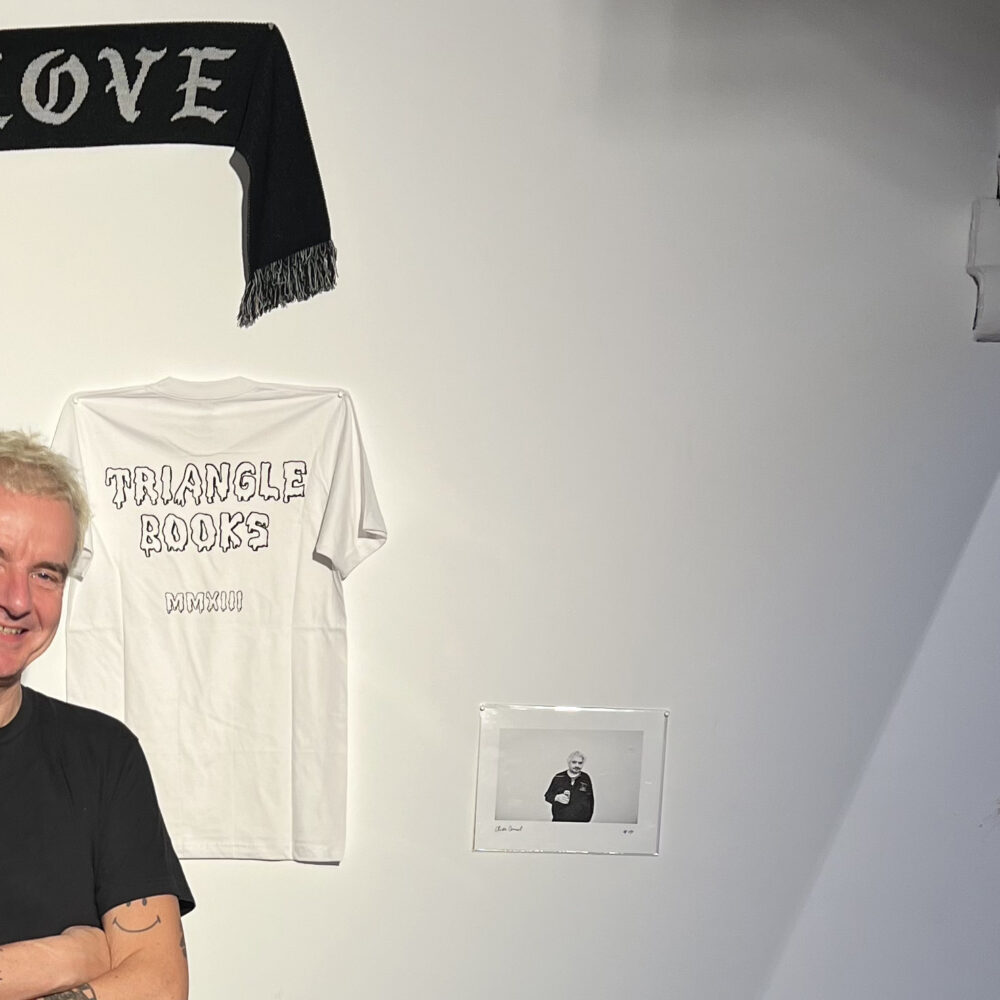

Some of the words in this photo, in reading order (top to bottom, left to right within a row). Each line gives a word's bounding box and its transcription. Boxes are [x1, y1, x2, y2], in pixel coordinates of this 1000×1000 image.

[104, 460, 307, 509] TRIANGLE
[140, 511, 270, 558] BOOKS
[165, 590, 243, 614] MMXIII
